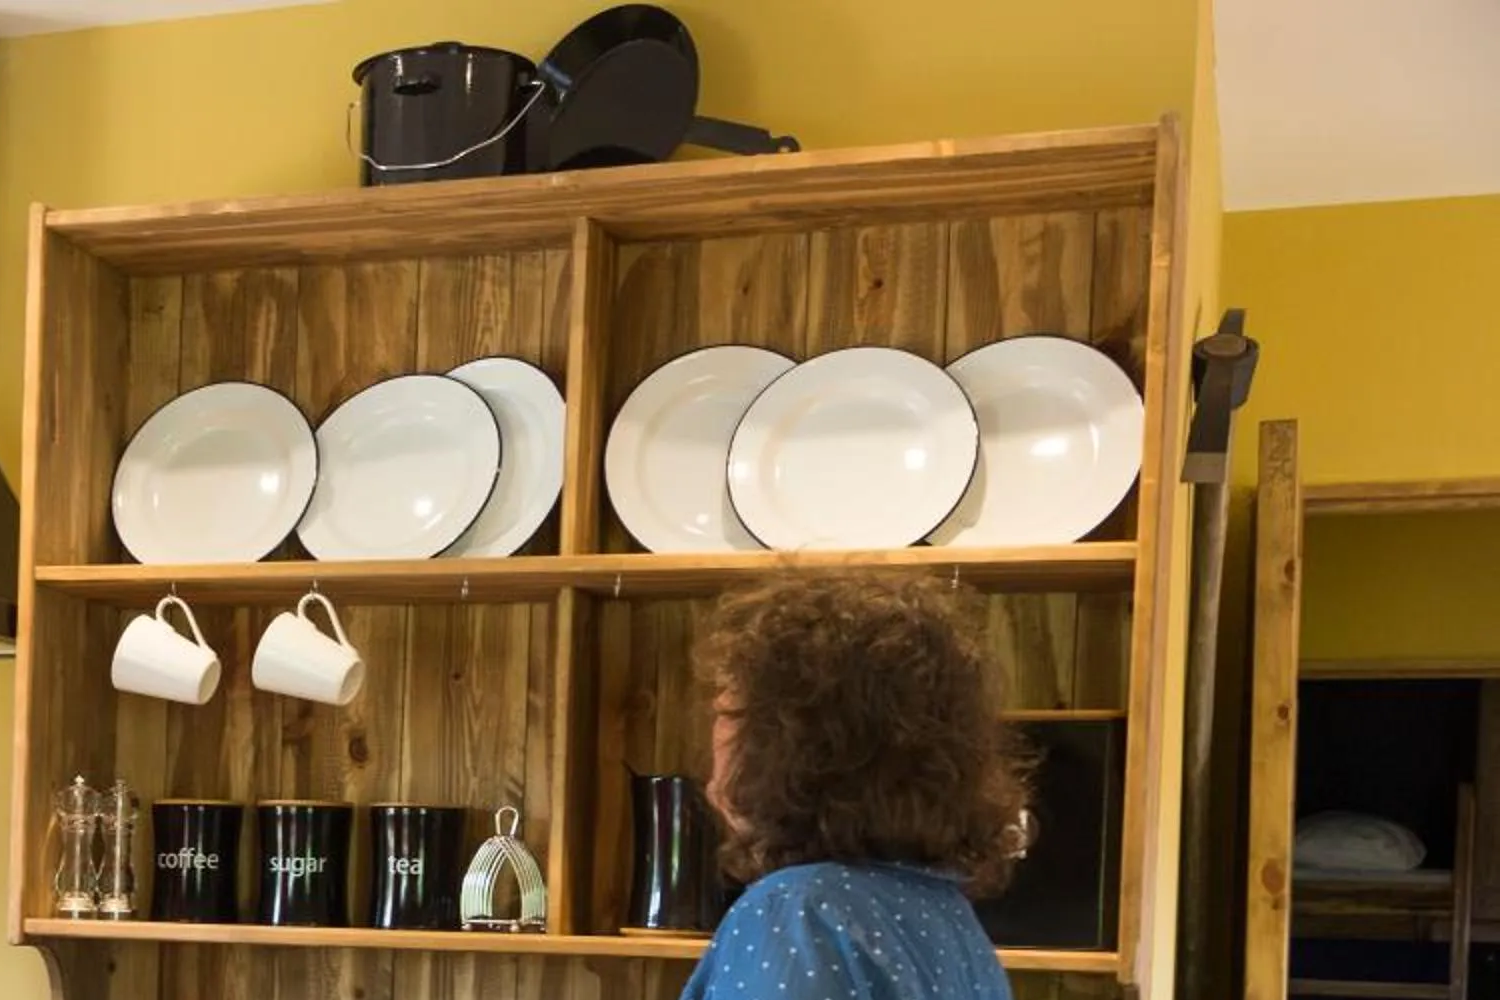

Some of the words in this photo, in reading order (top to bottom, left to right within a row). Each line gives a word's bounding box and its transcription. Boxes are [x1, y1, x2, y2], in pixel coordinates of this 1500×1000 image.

[157, 847, 219, 869] coffee
[269, 855, 327, 877] sugar
[388, 855, 425, 875] tea
